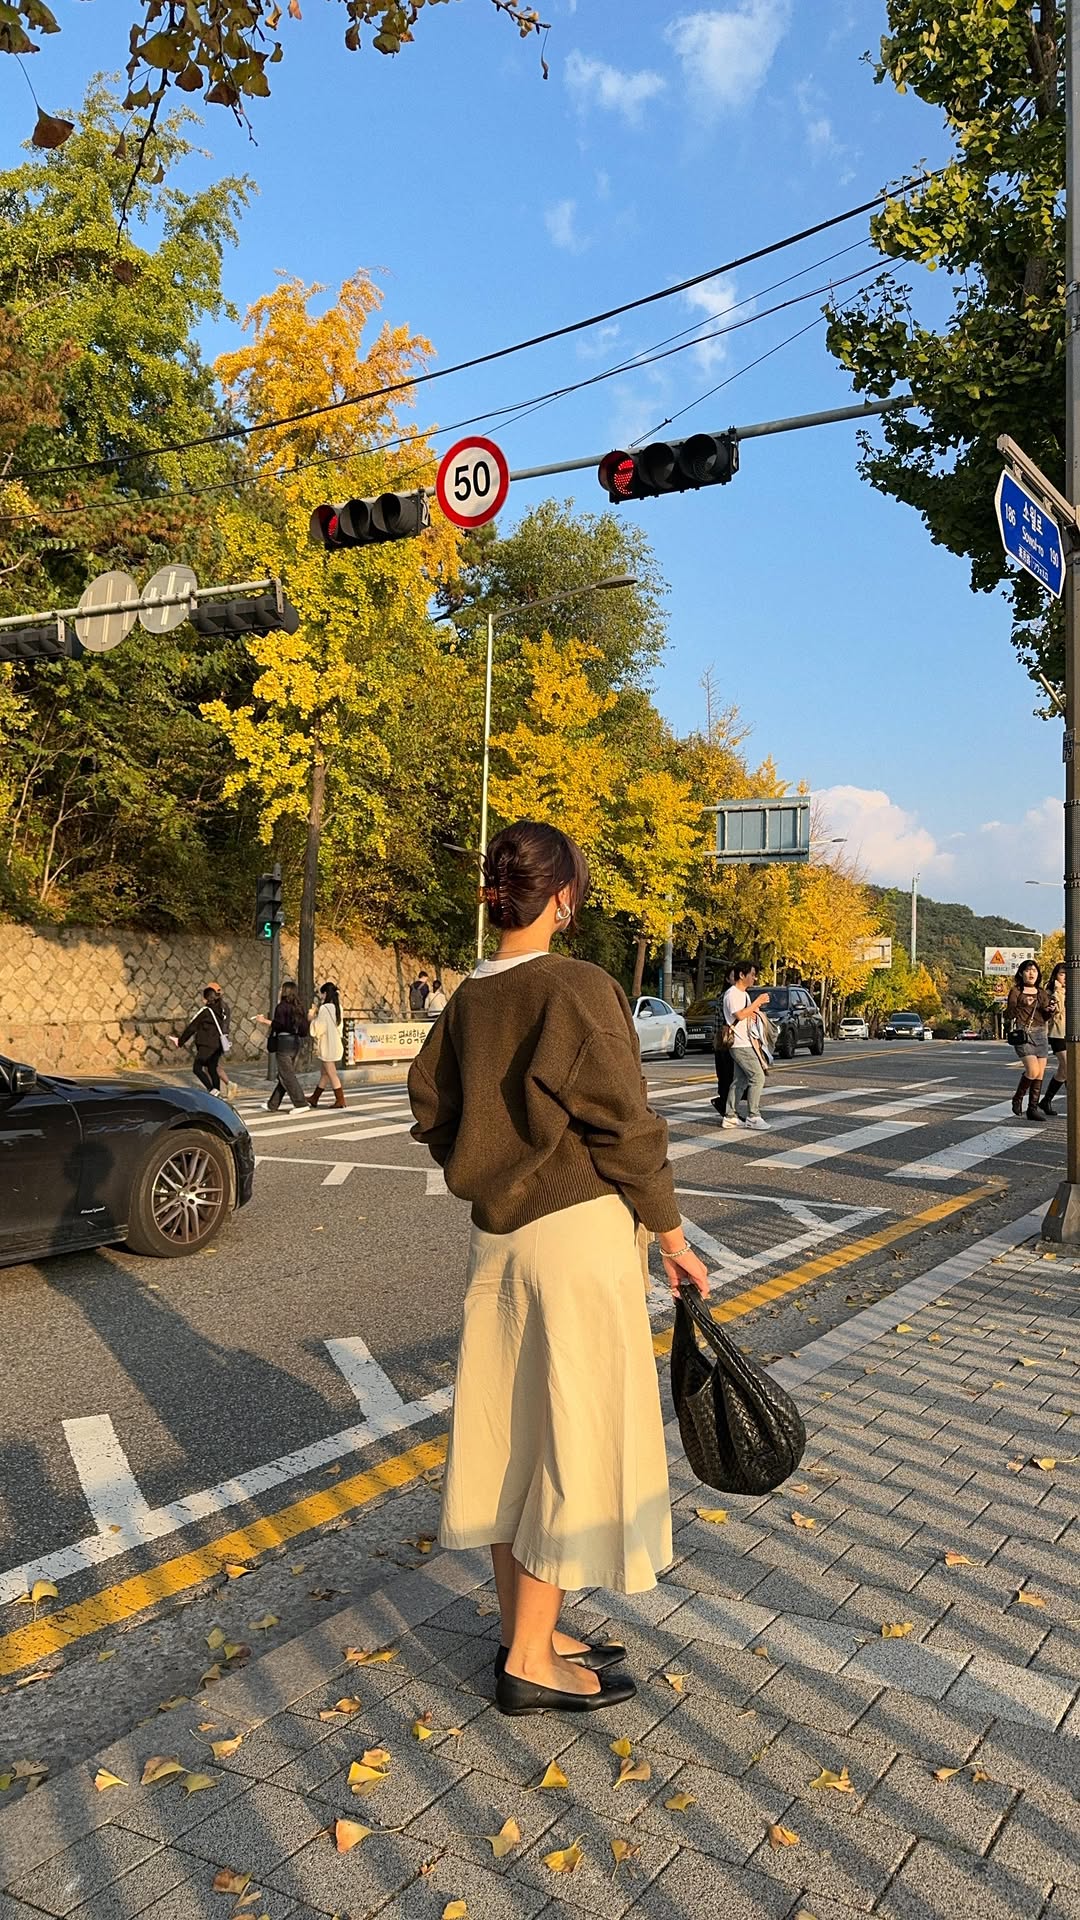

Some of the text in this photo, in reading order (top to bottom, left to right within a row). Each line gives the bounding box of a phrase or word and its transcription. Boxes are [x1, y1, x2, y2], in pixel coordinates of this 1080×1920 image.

[454, 461, 491, 501] 50
[1005, 503, 1017, 526] 186
[1022, 501, 1043, 535] 소월로
[1049, 547, 1059, 569] 190
[264, 922, 272, 938] 5
